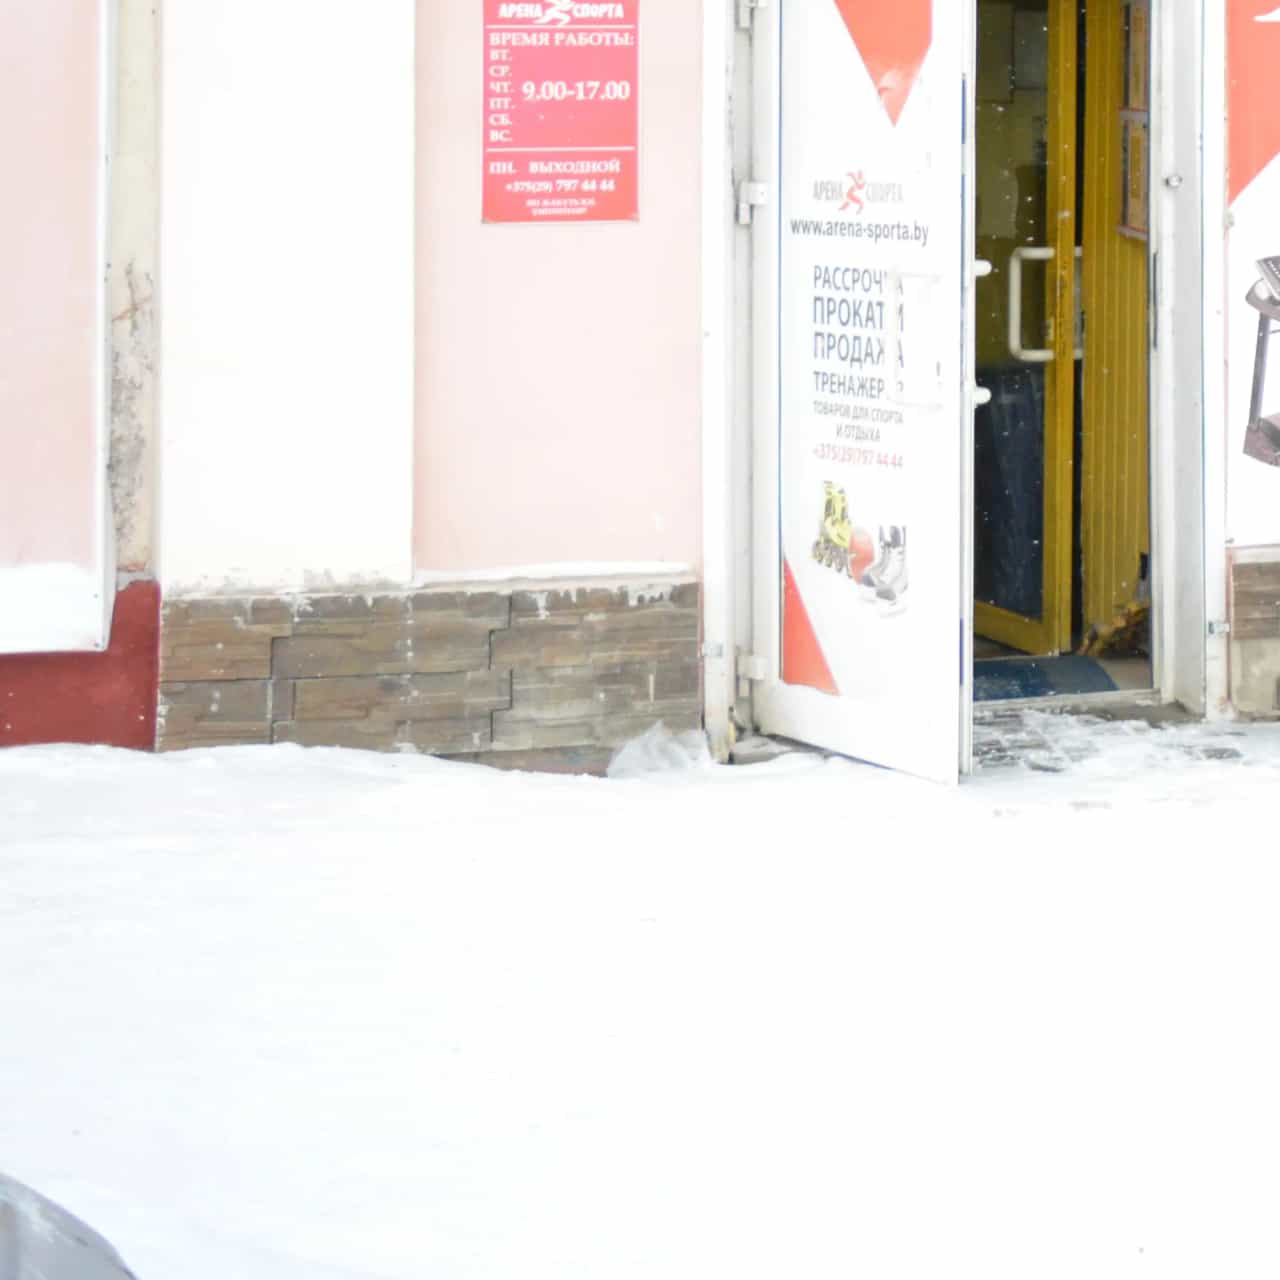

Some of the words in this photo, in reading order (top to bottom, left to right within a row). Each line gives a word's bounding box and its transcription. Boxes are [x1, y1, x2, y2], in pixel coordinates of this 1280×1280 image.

[499, 3, 542, 18] АРЕНА
[573, 3, 624, 18] СПОРТА
[489, 31, 550, 47] ВРЕМЯ
[553, 31, 634, 47] РАБОТЫ:
[521, 80, 631, 101] 9.00-17.00
[790, 219, 929, 247] www.arena-sporta.by
[813, 264, 904, 293] РАССРОЧА
[813, 296, 886, 329] ПРОКАТ
[813, 370, 904, 399] ТРЕНАЖЕР
